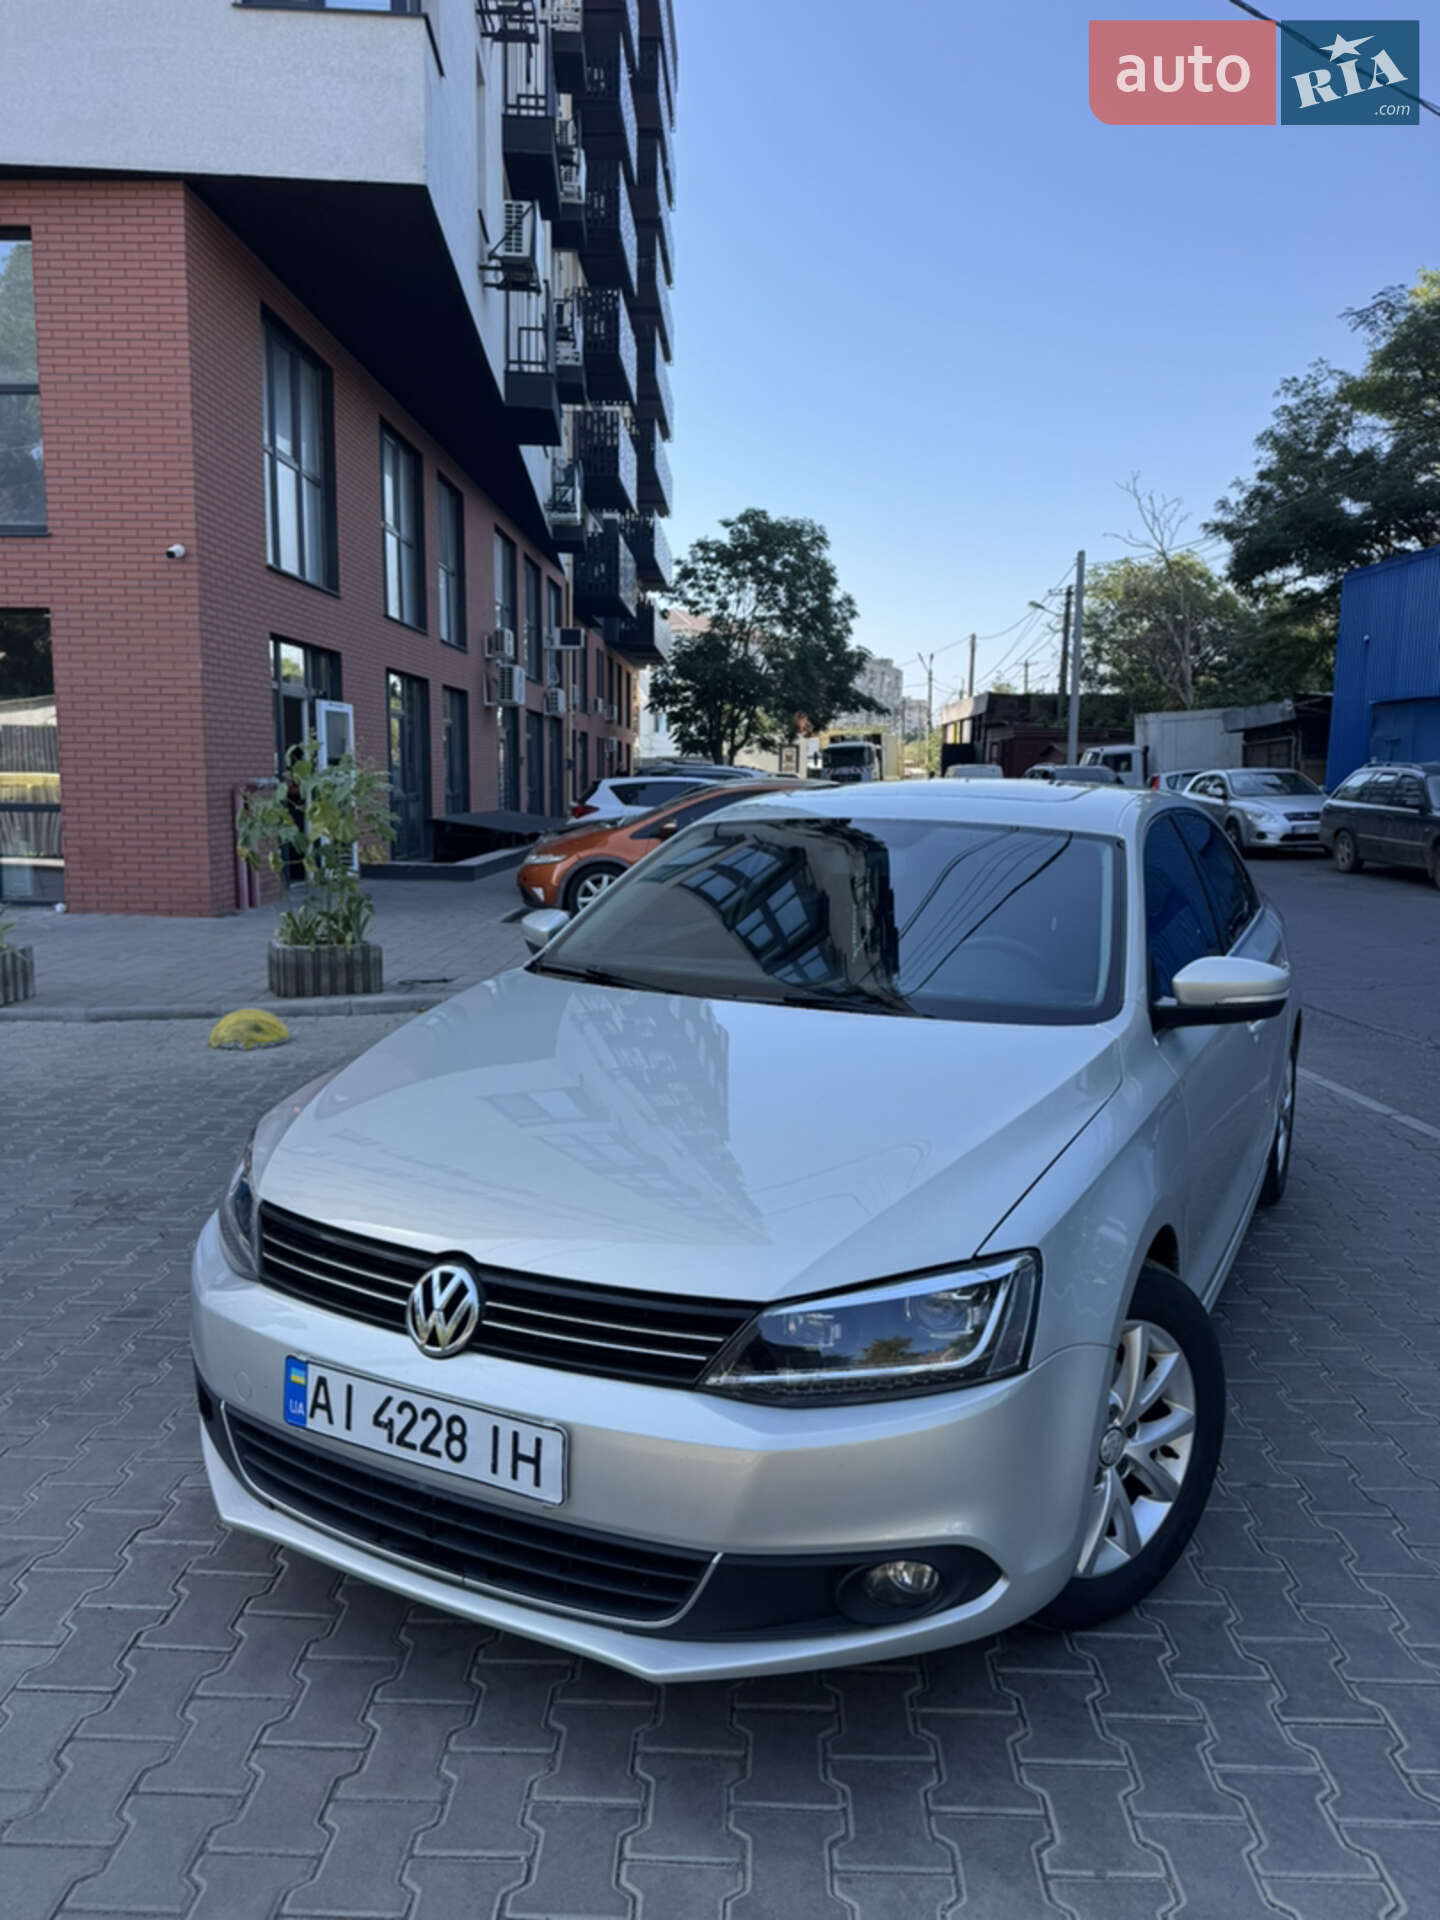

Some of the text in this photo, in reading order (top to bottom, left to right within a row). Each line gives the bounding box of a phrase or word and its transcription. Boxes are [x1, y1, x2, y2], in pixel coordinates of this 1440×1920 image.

[289, 1398, 305, 1417] UA
[309, 1375, 543, 1488] AI 4228 IH
